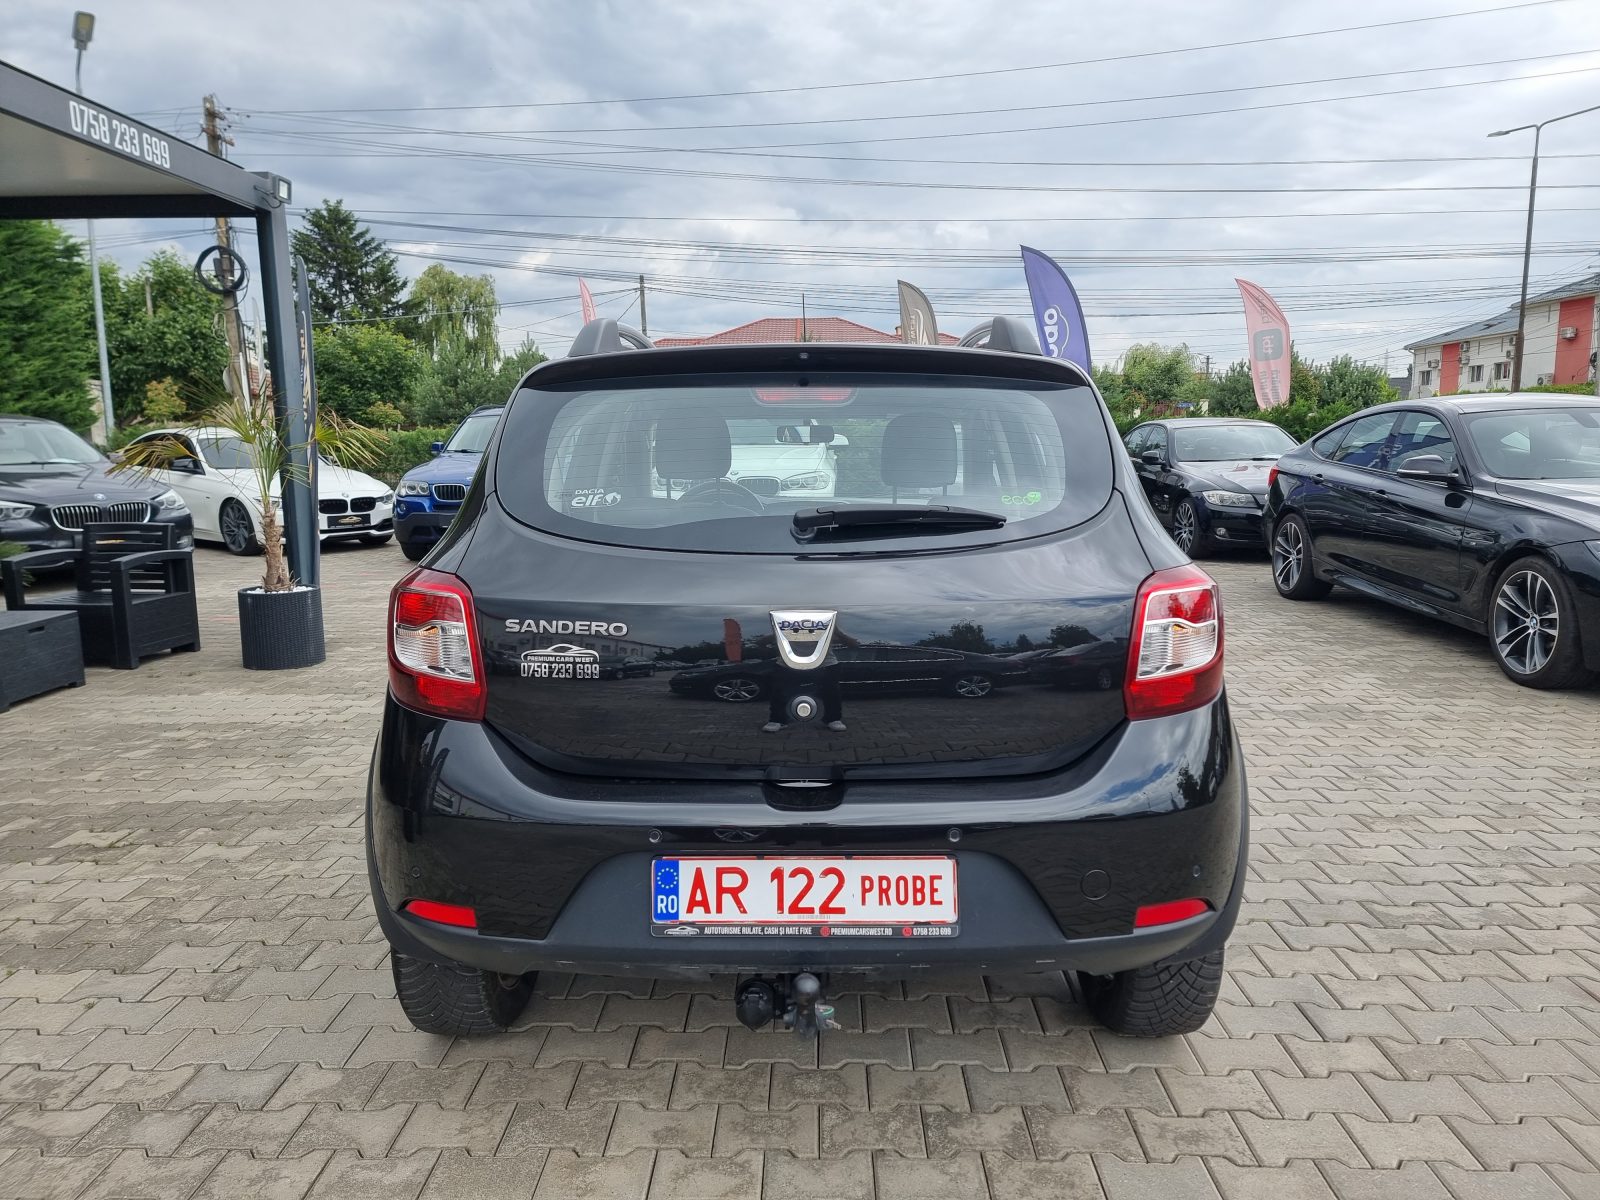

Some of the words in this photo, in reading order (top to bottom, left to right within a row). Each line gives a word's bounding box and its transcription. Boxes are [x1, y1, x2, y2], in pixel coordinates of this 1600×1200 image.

[69, 100, 111, 145] 0758
[112, 119, 141, 157] 233
[142, 132, 171, 169] 699
[571, 494, 604, 507] elf
[505, 618, 628, 637] SANDERO
[781, 619, 826, 629] DACIA
[527, 655, 556, 663] PREMIUM
[520, 662, 549, 678] 0758
[551, 663, 573, 679] 233
[576, 664, 600, 679] 699
[686, 866, 749, 915] AR
[770, 866, 847, 915] 122
[860, 874, 943, 907] PROBE
[657, 894, 678, 914] RO
[704, 926, 741, 935] AUTOTURISME
[741, 926, 763, 936] RULATE,
[764, 926, 778, 935] CASH
[785, 926, 799, 935] RATE
[799, 926, 812, 935] FIXE
[831, 927, 892, 936] PREMIUMCARSWEST.RO
[913, 927, 928, 936] 0758
[928, 927, 939, 936] 233
